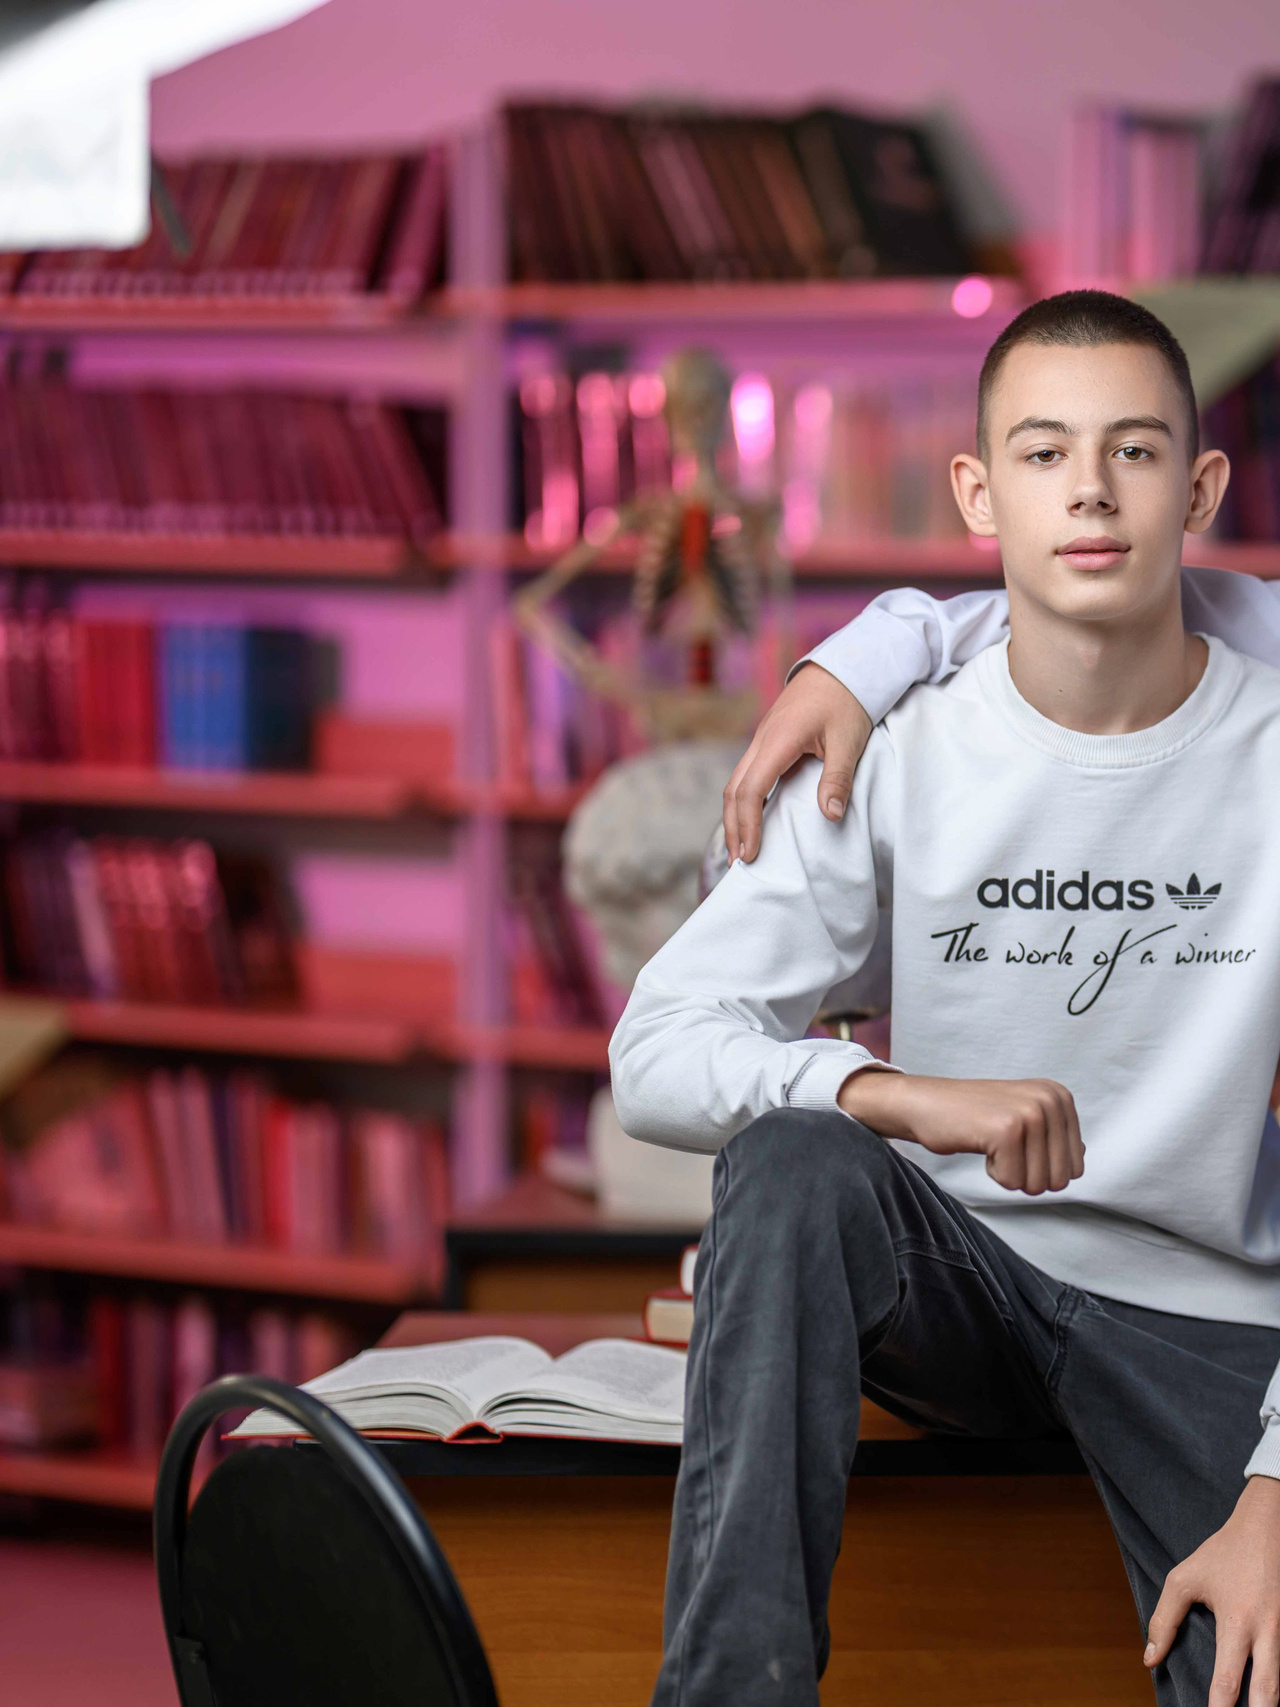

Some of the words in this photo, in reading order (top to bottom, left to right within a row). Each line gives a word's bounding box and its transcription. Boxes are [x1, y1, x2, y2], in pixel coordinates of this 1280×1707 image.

[977, 869, 1155, 912] adidas
[930, 922, 989, 964] The
[1005, 925, 1074, 966] work
[1067, 923, 1178, 1016] of
[1140, 949, 1158, 965] a
[1175, 932, 1257, 965] winner
